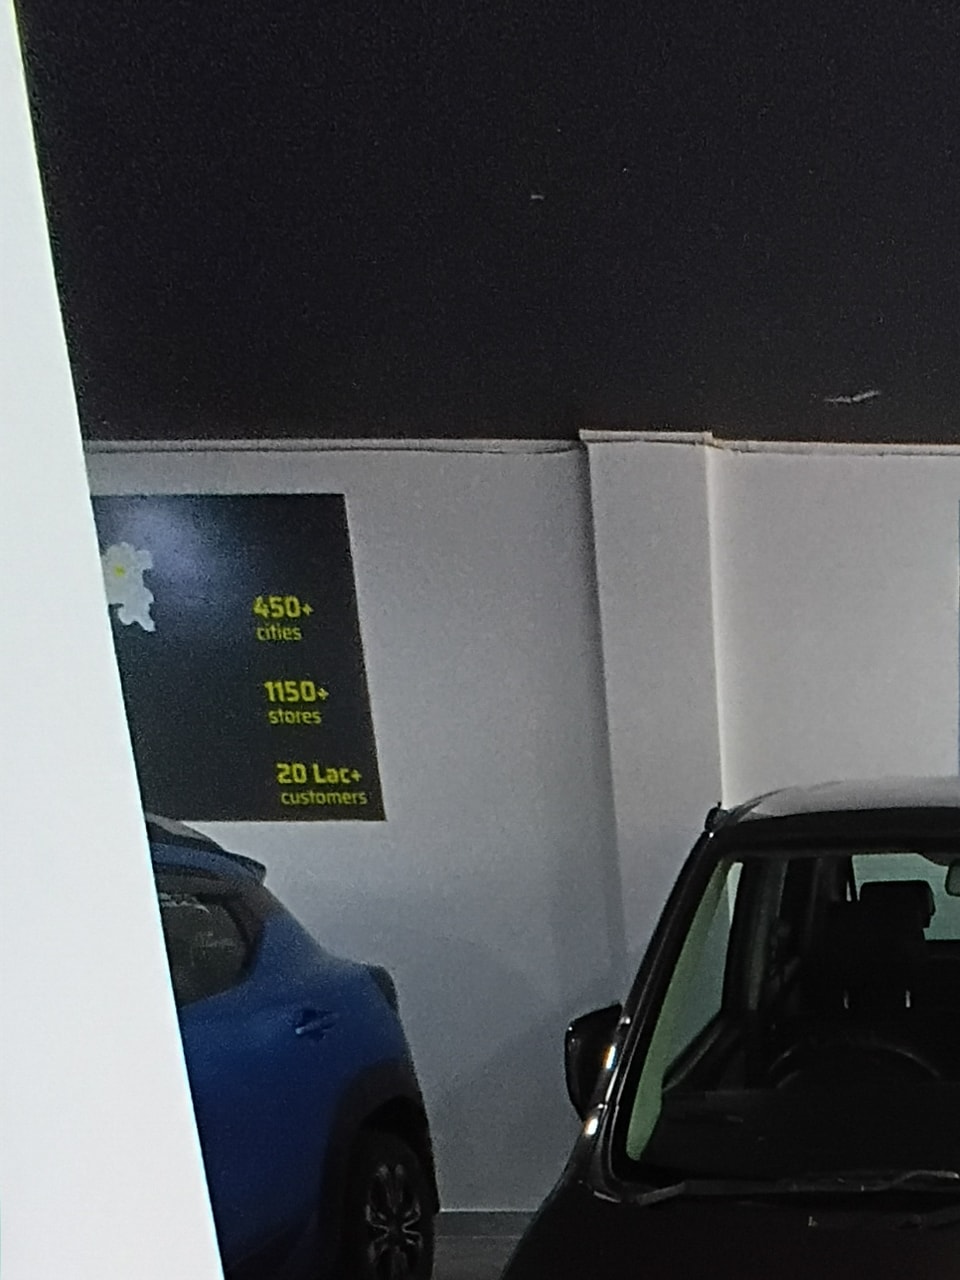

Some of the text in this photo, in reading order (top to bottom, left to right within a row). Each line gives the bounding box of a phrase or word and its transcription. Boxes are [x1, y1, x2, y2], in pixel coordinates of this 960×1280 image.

[253, 595, 314, 619] 450+
[256, 625, 302, 641] cities
[264, 681, 329, 702] 1150+
[268, 709, 322, 724] stores
[276, 763, 362, 784] 20 Lac+
[280, 791, 368, 805] customers
